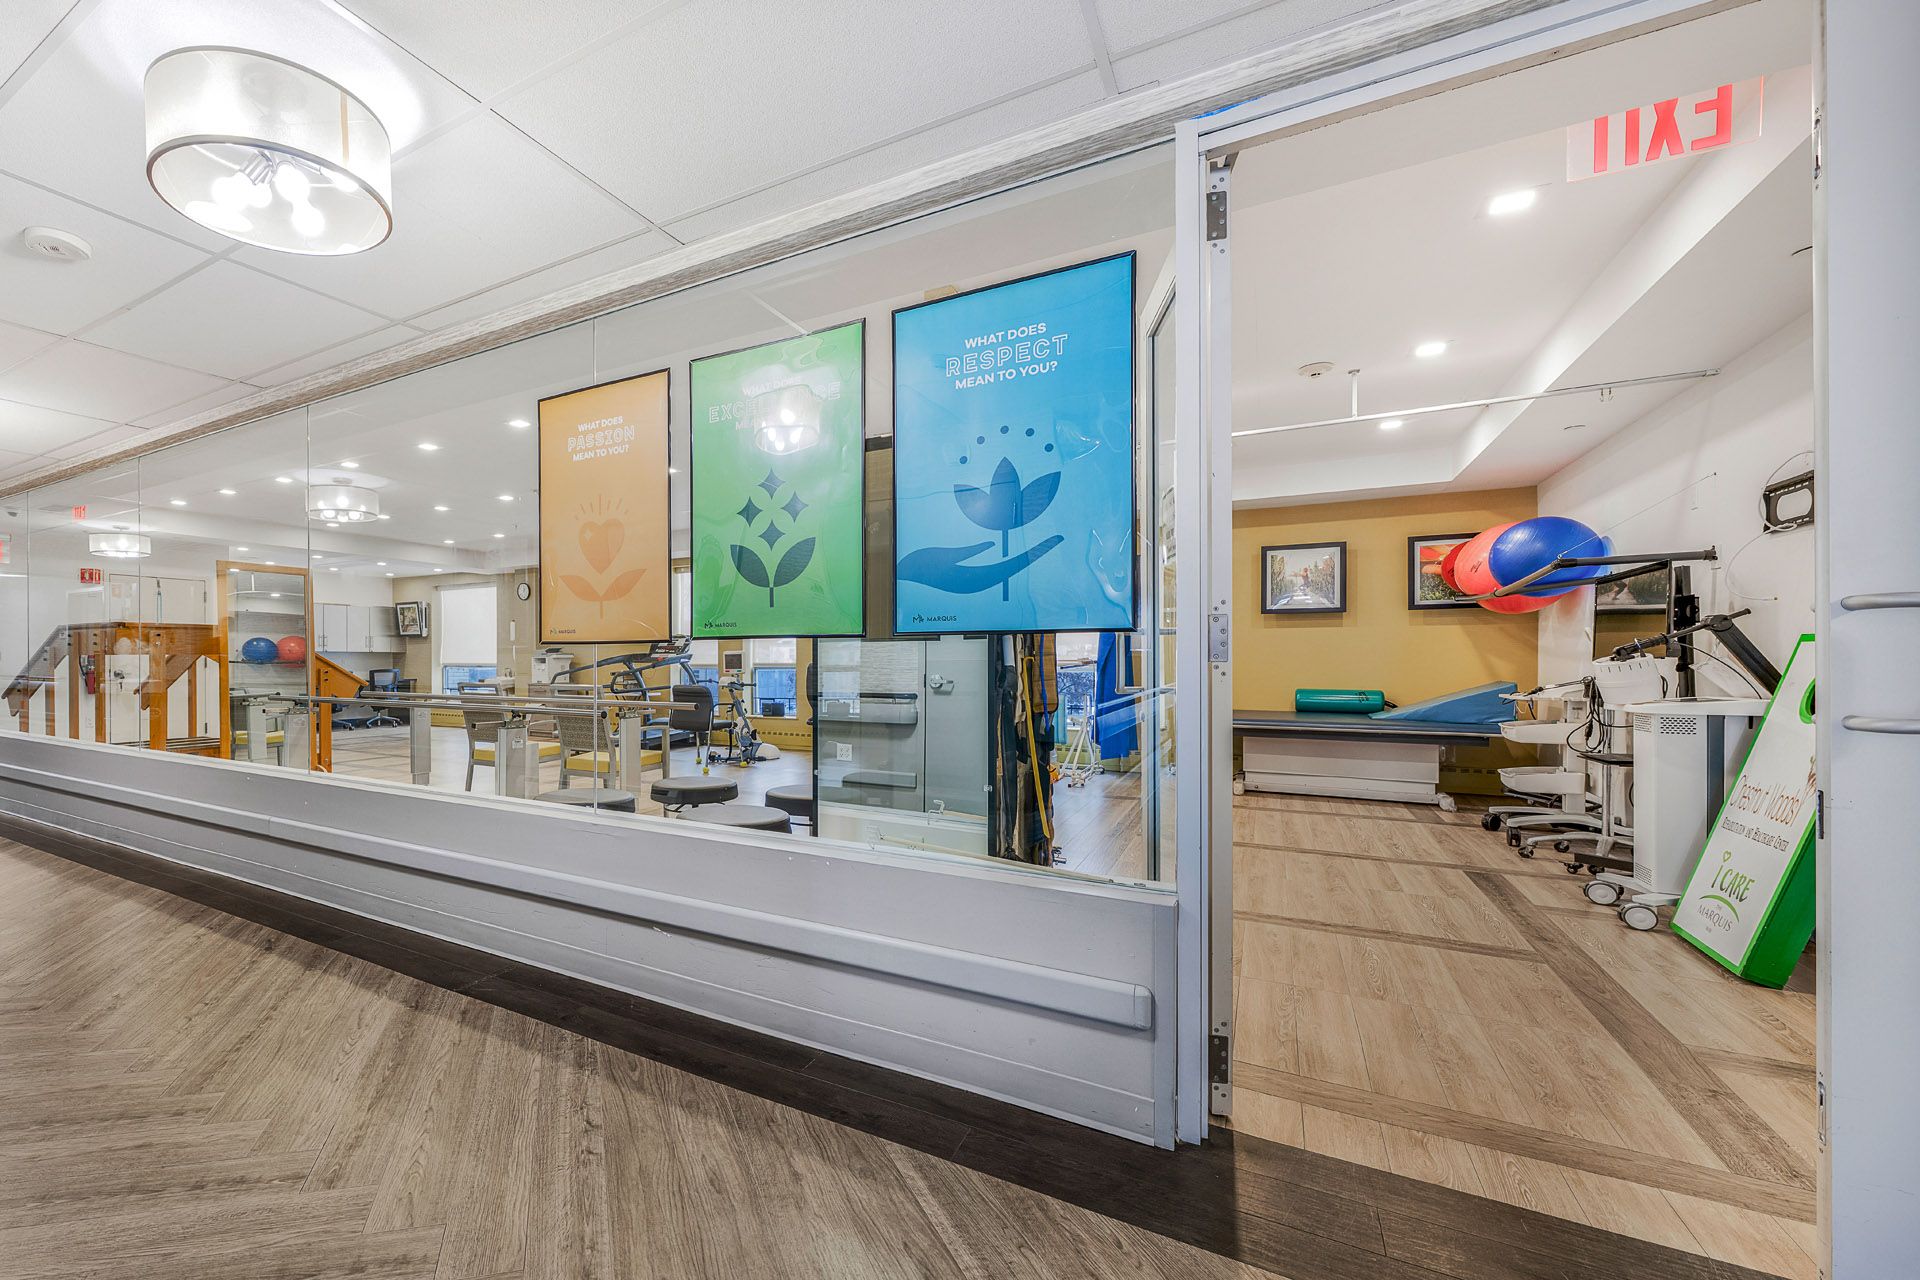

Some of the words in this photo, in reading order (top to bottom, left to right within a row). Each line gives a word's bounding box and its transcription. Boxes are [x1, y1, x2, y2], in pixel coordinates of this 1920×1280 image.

[965, 331, 1004, 349] WHAT
[1007, 322, 1047, 340] DOES
[945, 334, 1068, 377] RESPECT
[955, 372, 995, 390] MEAN
[997, 368, 1017, 382] TO
[1019, 360, 1058, 377] YOU?
[578, 419, 600, 432] WHAT
[601, 415, 624, 428] DOES
[567, 425, 635, 452] PASSION
[572, 450, 595, 462] MEAN
[596, 448, 607, 458] TO
[608, 444, 630, 455] YOU?
[1720, 868, 1755, 902] CARE
[1697, 904, 1733, 932] MARQUIS
